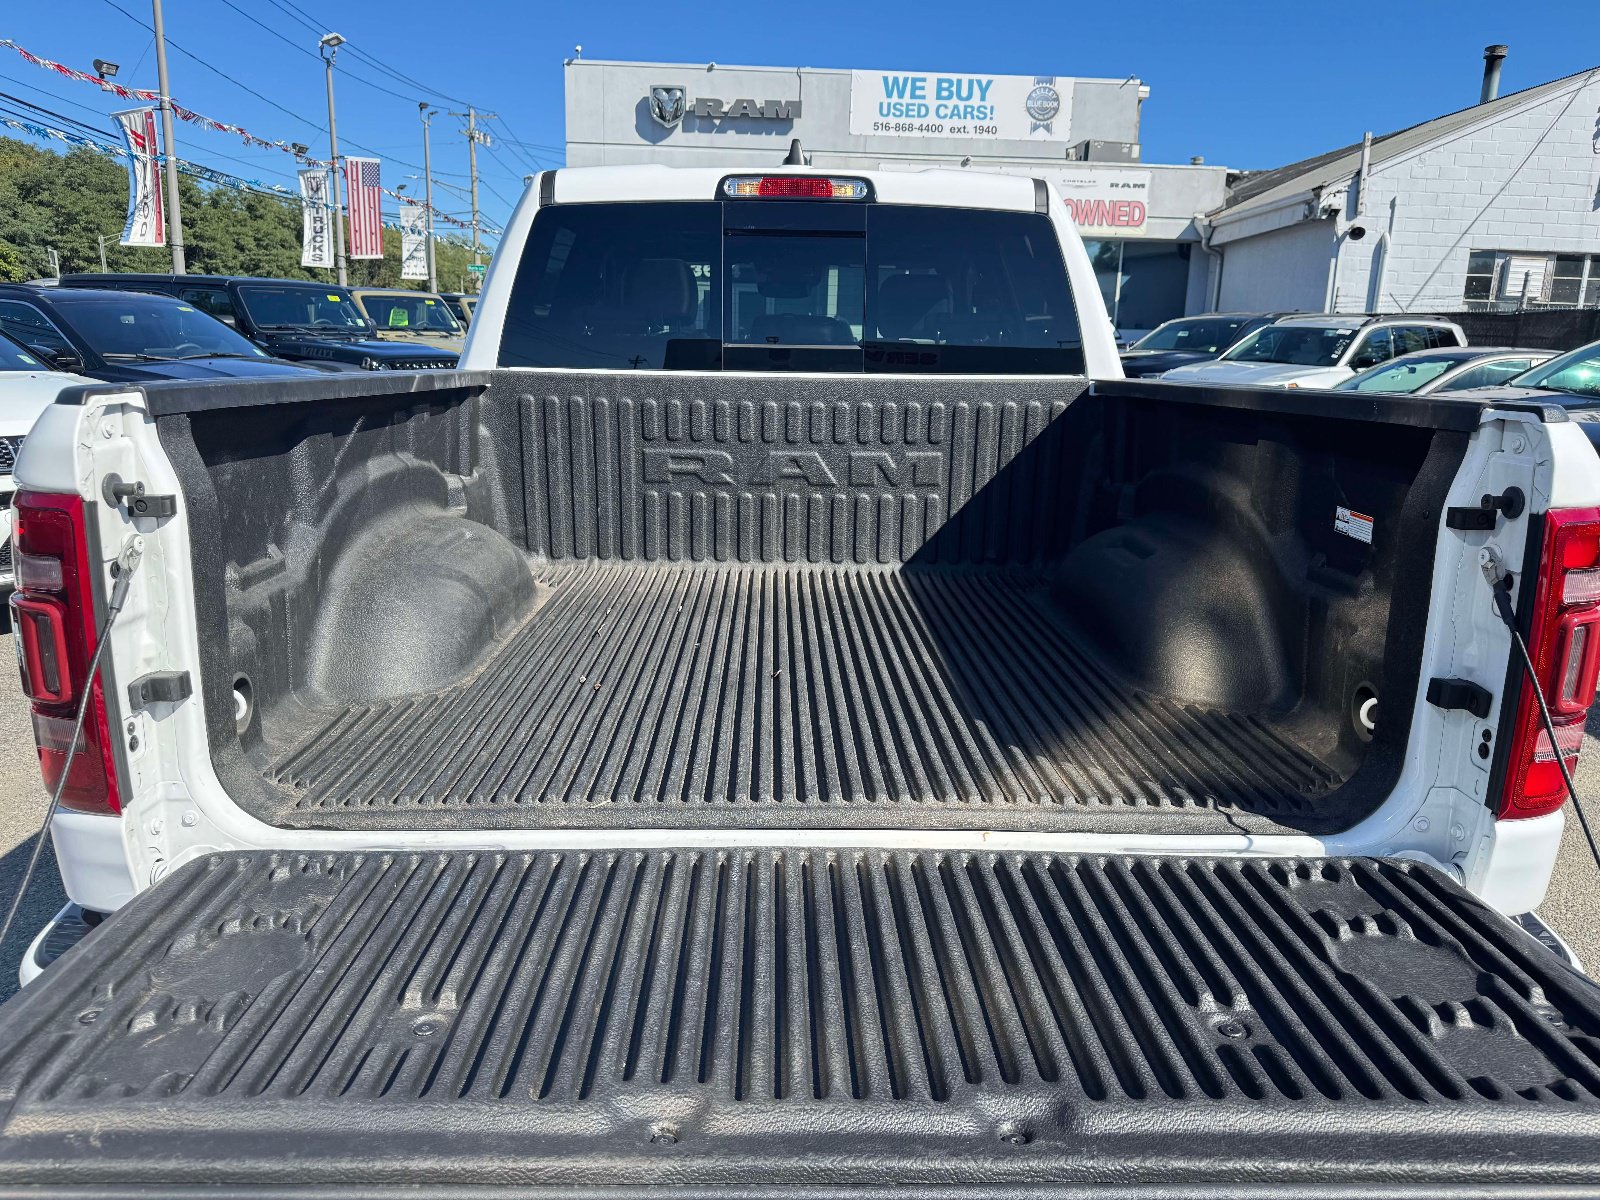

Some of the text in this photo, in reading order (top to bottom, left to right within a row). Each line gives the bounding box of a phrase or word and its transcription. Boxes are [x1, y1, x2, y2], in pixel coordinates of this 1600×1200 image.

[882, 75, 994, 102] WE BUY
[1031, 87, 1058, 99] KELLEY
[695, 97, 803, 119] RAM
[879, 101, 994, 121] USED CARS!
[1027, 100, 1059, 108] BLUE BOOK
[873, 121, 998, 135] 516-868-4400 ext. 1940
[311, 203, 324, 262] TRUCKS
[642, 448, 943, 488] RAM
